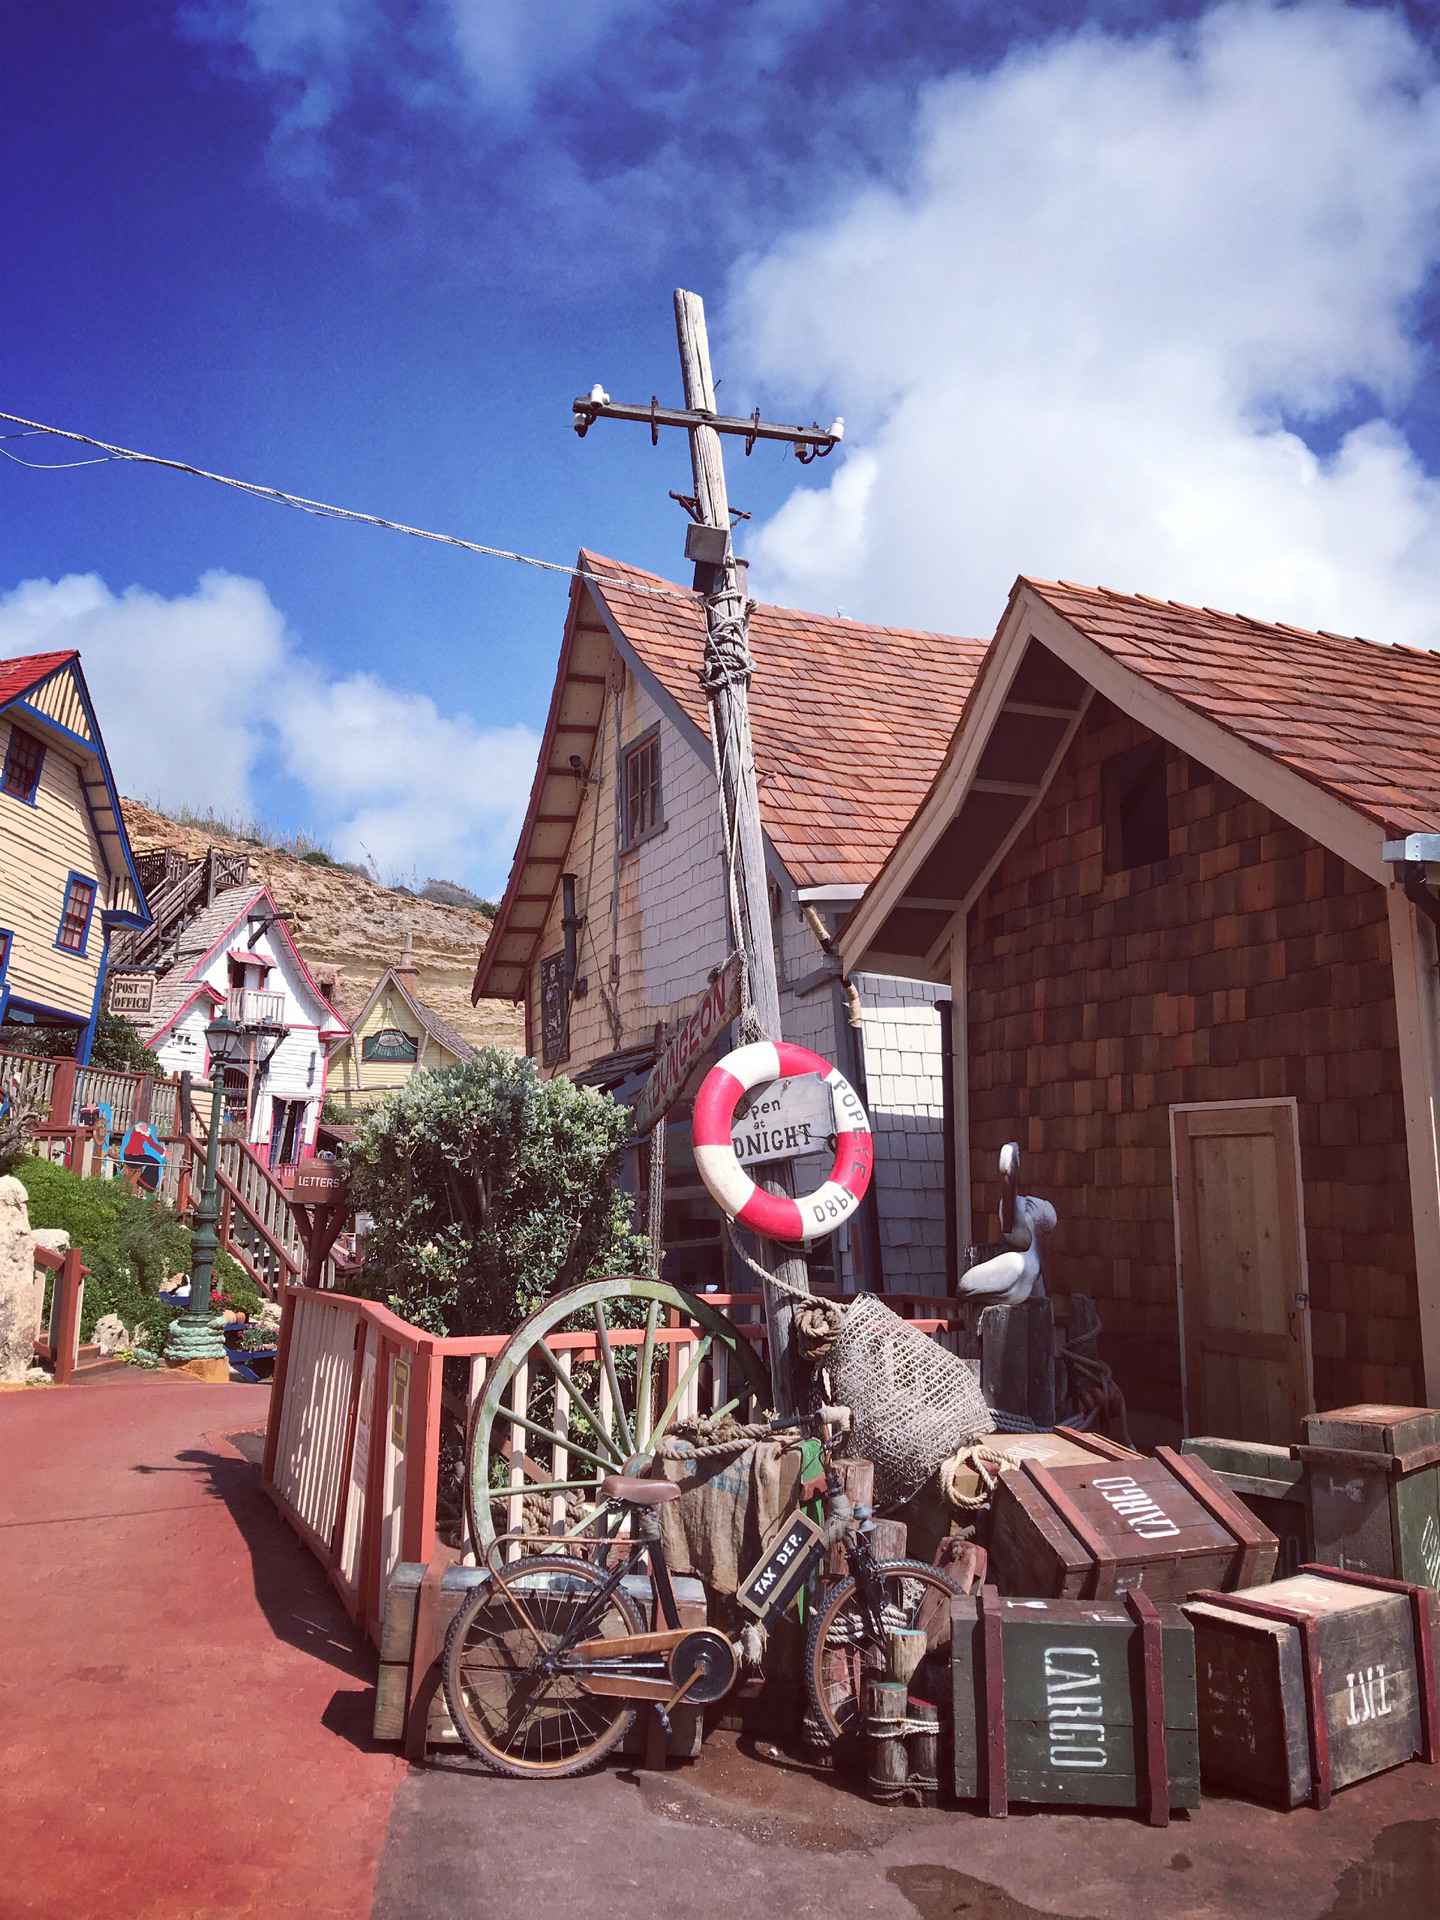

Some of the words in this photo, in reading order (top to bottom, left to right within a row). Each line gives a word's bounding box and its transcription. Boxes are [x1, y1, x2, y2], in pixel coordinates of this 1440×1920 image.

[114, 997, 148, 1009] OFFICE
[115, 983, 139, 993] POST
[749, 1099, 781, 1121] pen
[753, 1119, 766, 1130] at
[732, 1123, 812, 1159] DNIGHT
[833, 1079, 869, 1179] POPEYE
[298, 1175, 340, 1189] LETTERS
[813, 1187, 854, 1223] 1980
[1092, 1476, 1181, 1539] CARGO
[754, 1566, 777, 1595] TAX
[776, 1534, 802, 1565] DEP.
[1044, 1647, 1108, 1767] CARGO
